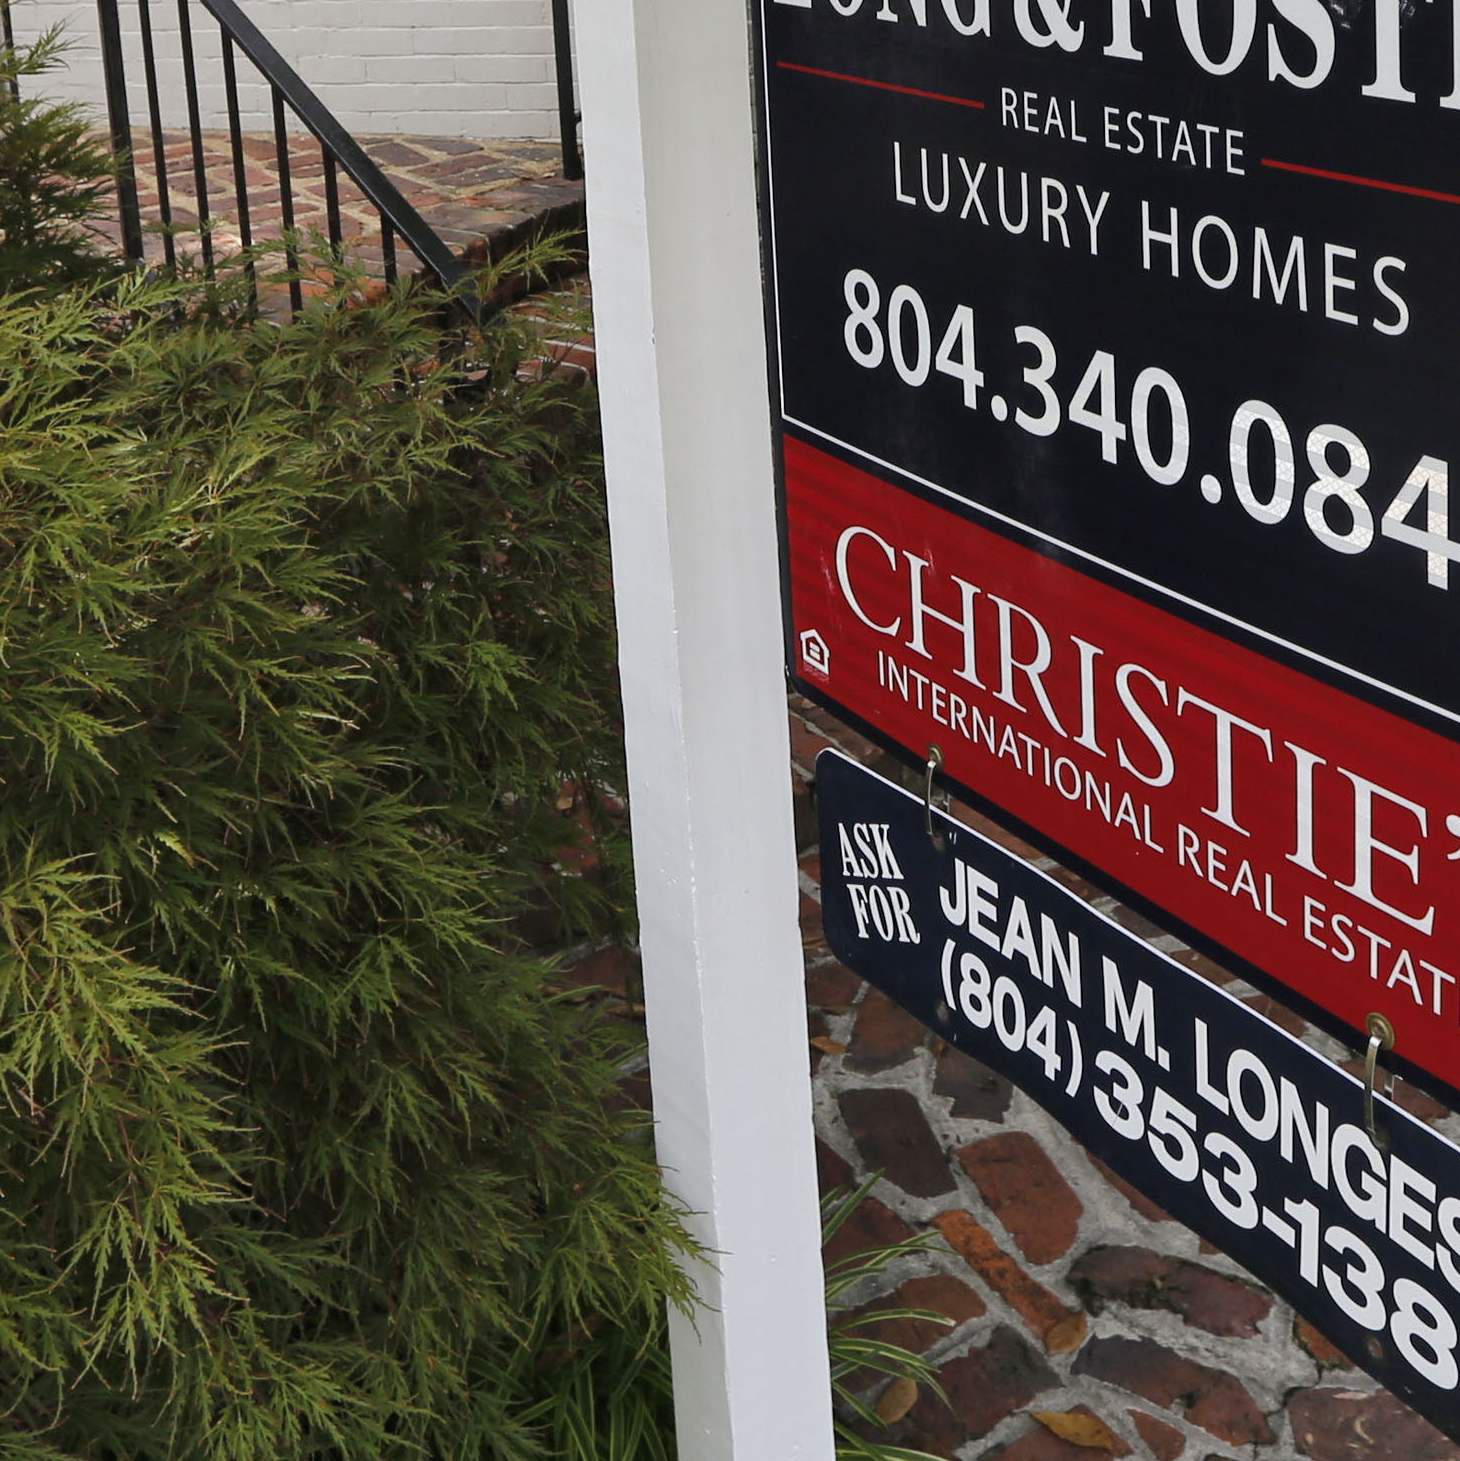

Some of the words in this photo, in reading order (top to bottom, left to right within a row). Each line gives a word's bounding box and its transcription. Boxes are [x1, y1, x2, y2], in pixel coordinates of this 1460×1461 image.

[1000, 86, 1087, 144] REAL
[1104, 108, 1246, 176] ESTATE
[892, 141, 1110, 256] LUXURY
[1142, 200, 1410, 337] HOMES
[837, 822, 903, 883] ASK
[877, 650, 1164, 854] INTERNATIONAL
[1178, 824, 1288, 928] REAL
[846, 882, 921, 947] FOR
[939, 857, 1082, 1008] JEAN
[1103, 962, 1170, 1072] M.
[941, 939, 1084, 1100] (804)
